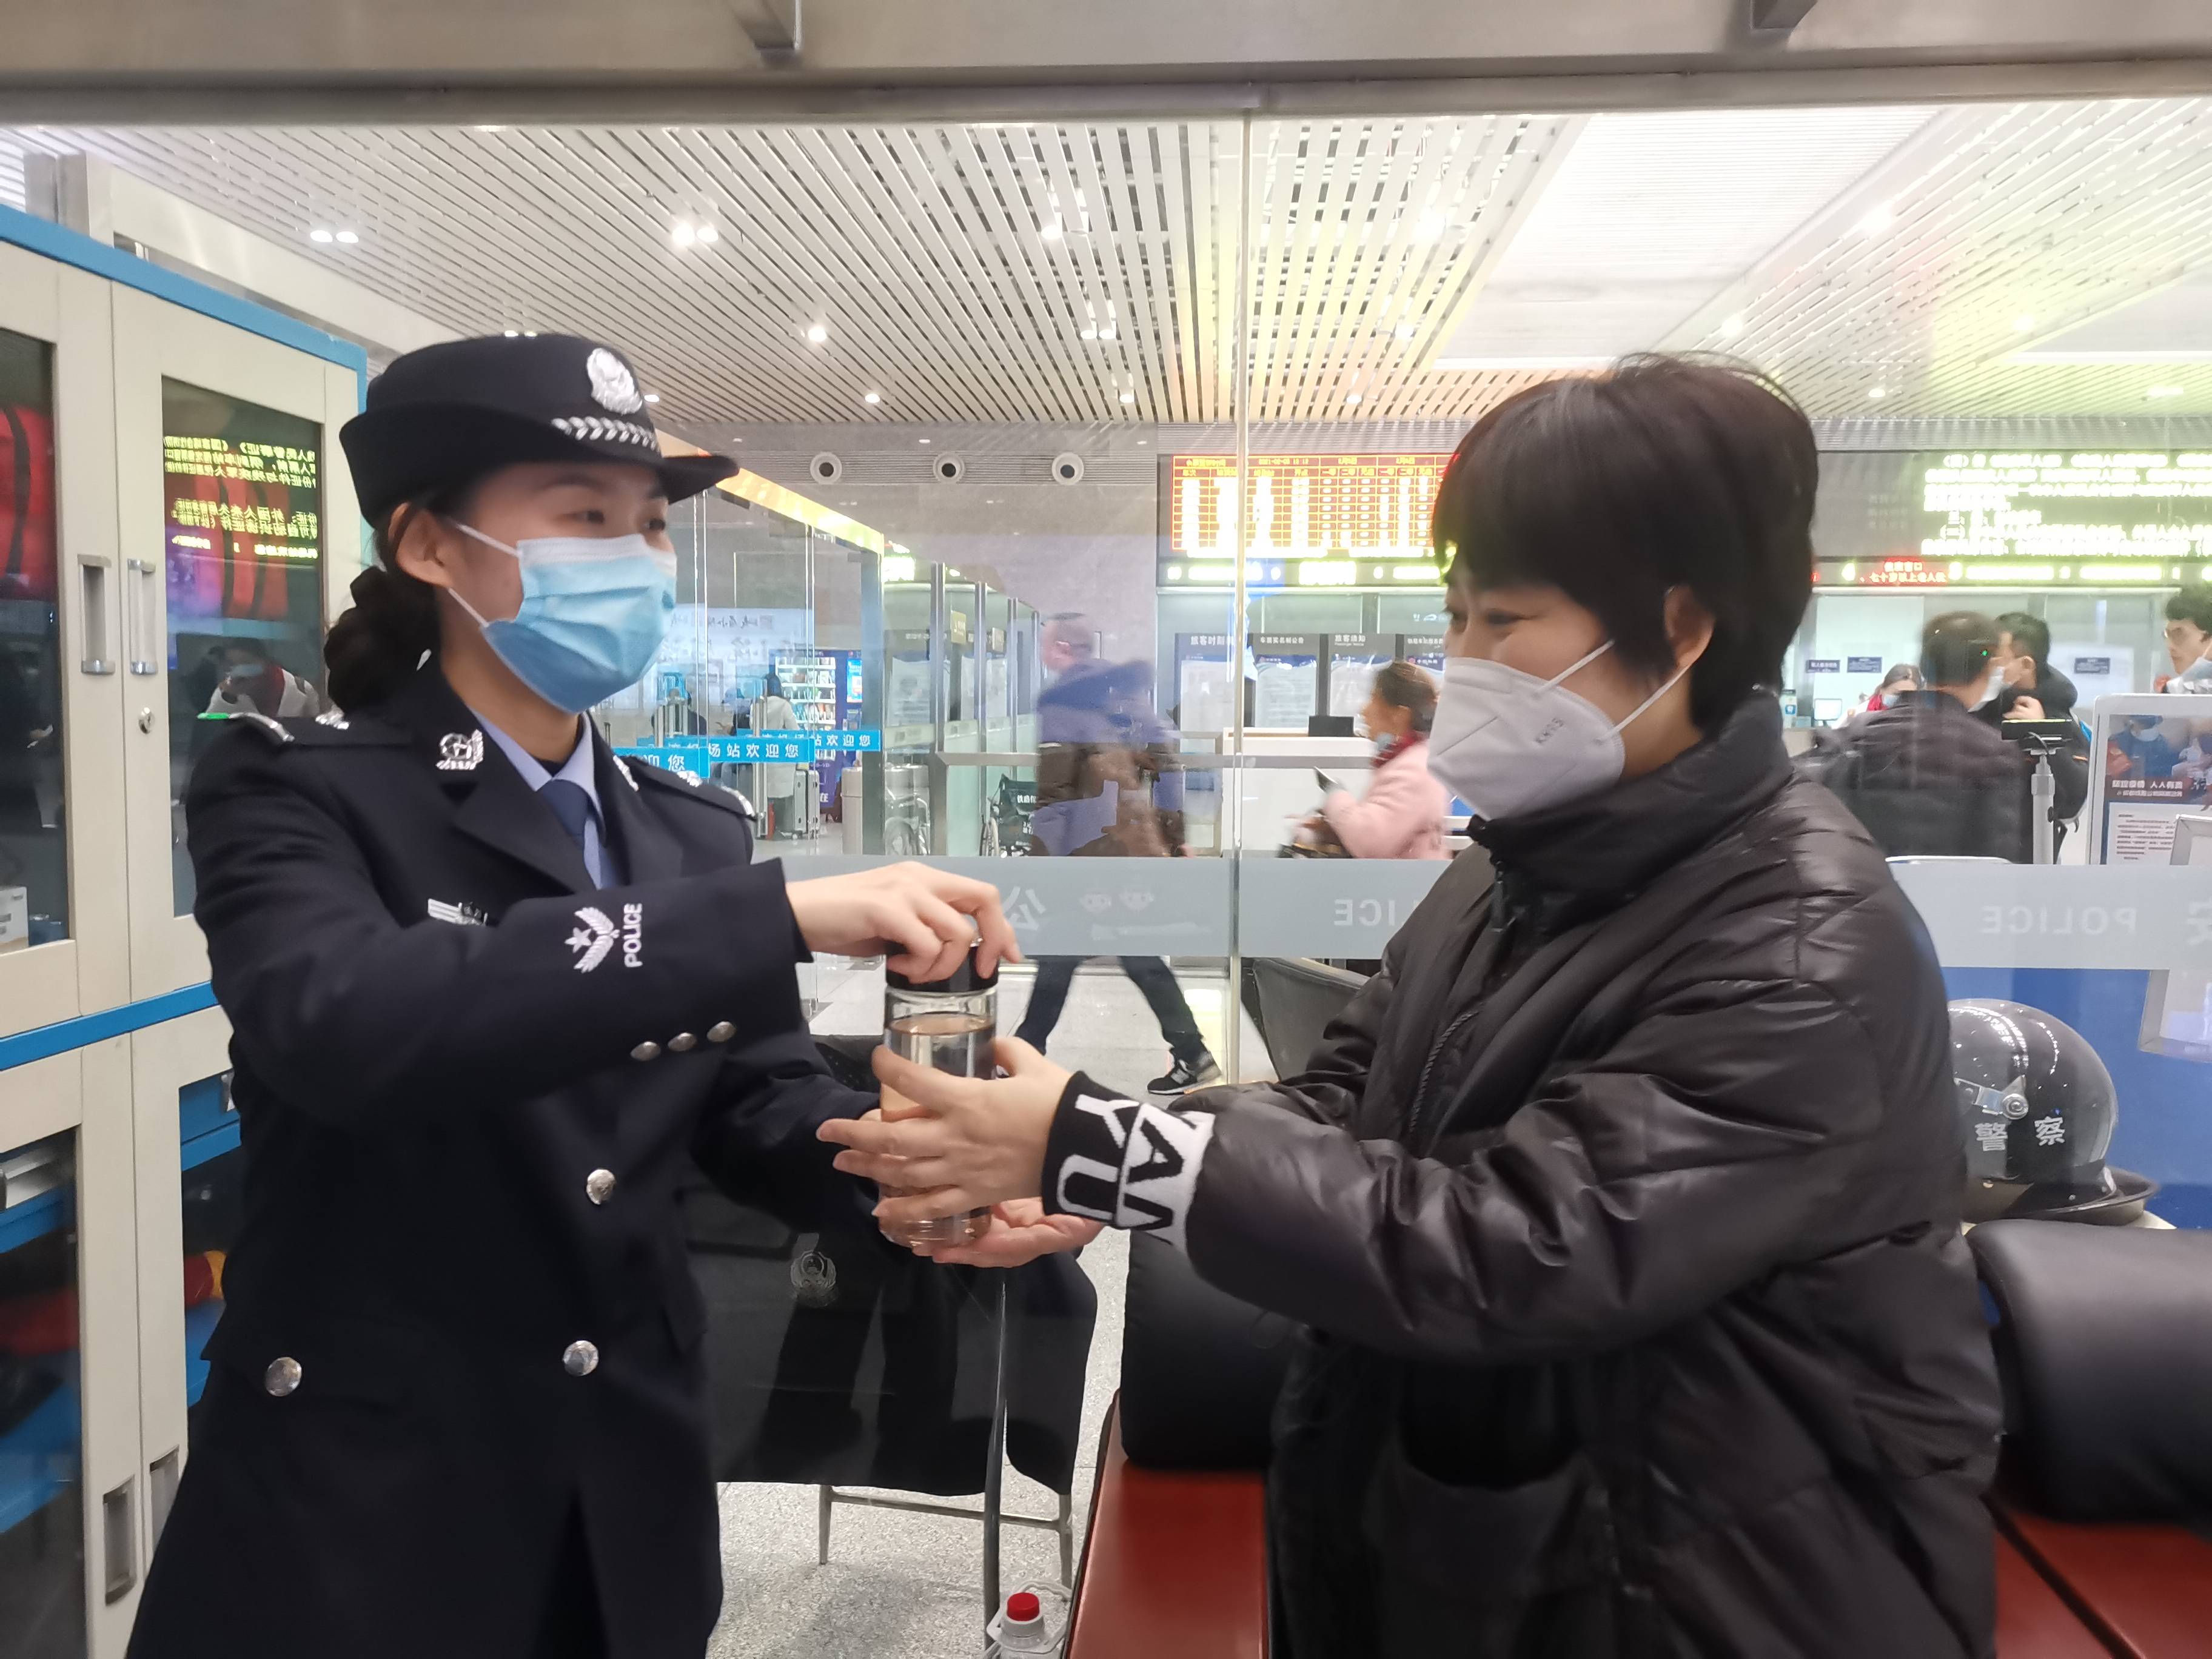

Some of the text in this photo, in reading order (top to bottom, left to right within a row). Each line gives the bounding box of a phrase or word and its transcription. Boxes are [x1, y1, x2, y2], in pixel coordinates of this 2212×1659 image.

[1335, 634, 1366, 643] 旅客须知
[623, 903, 643, 968] POLICE
[1974, 1116, 2065, 1151] 警察
